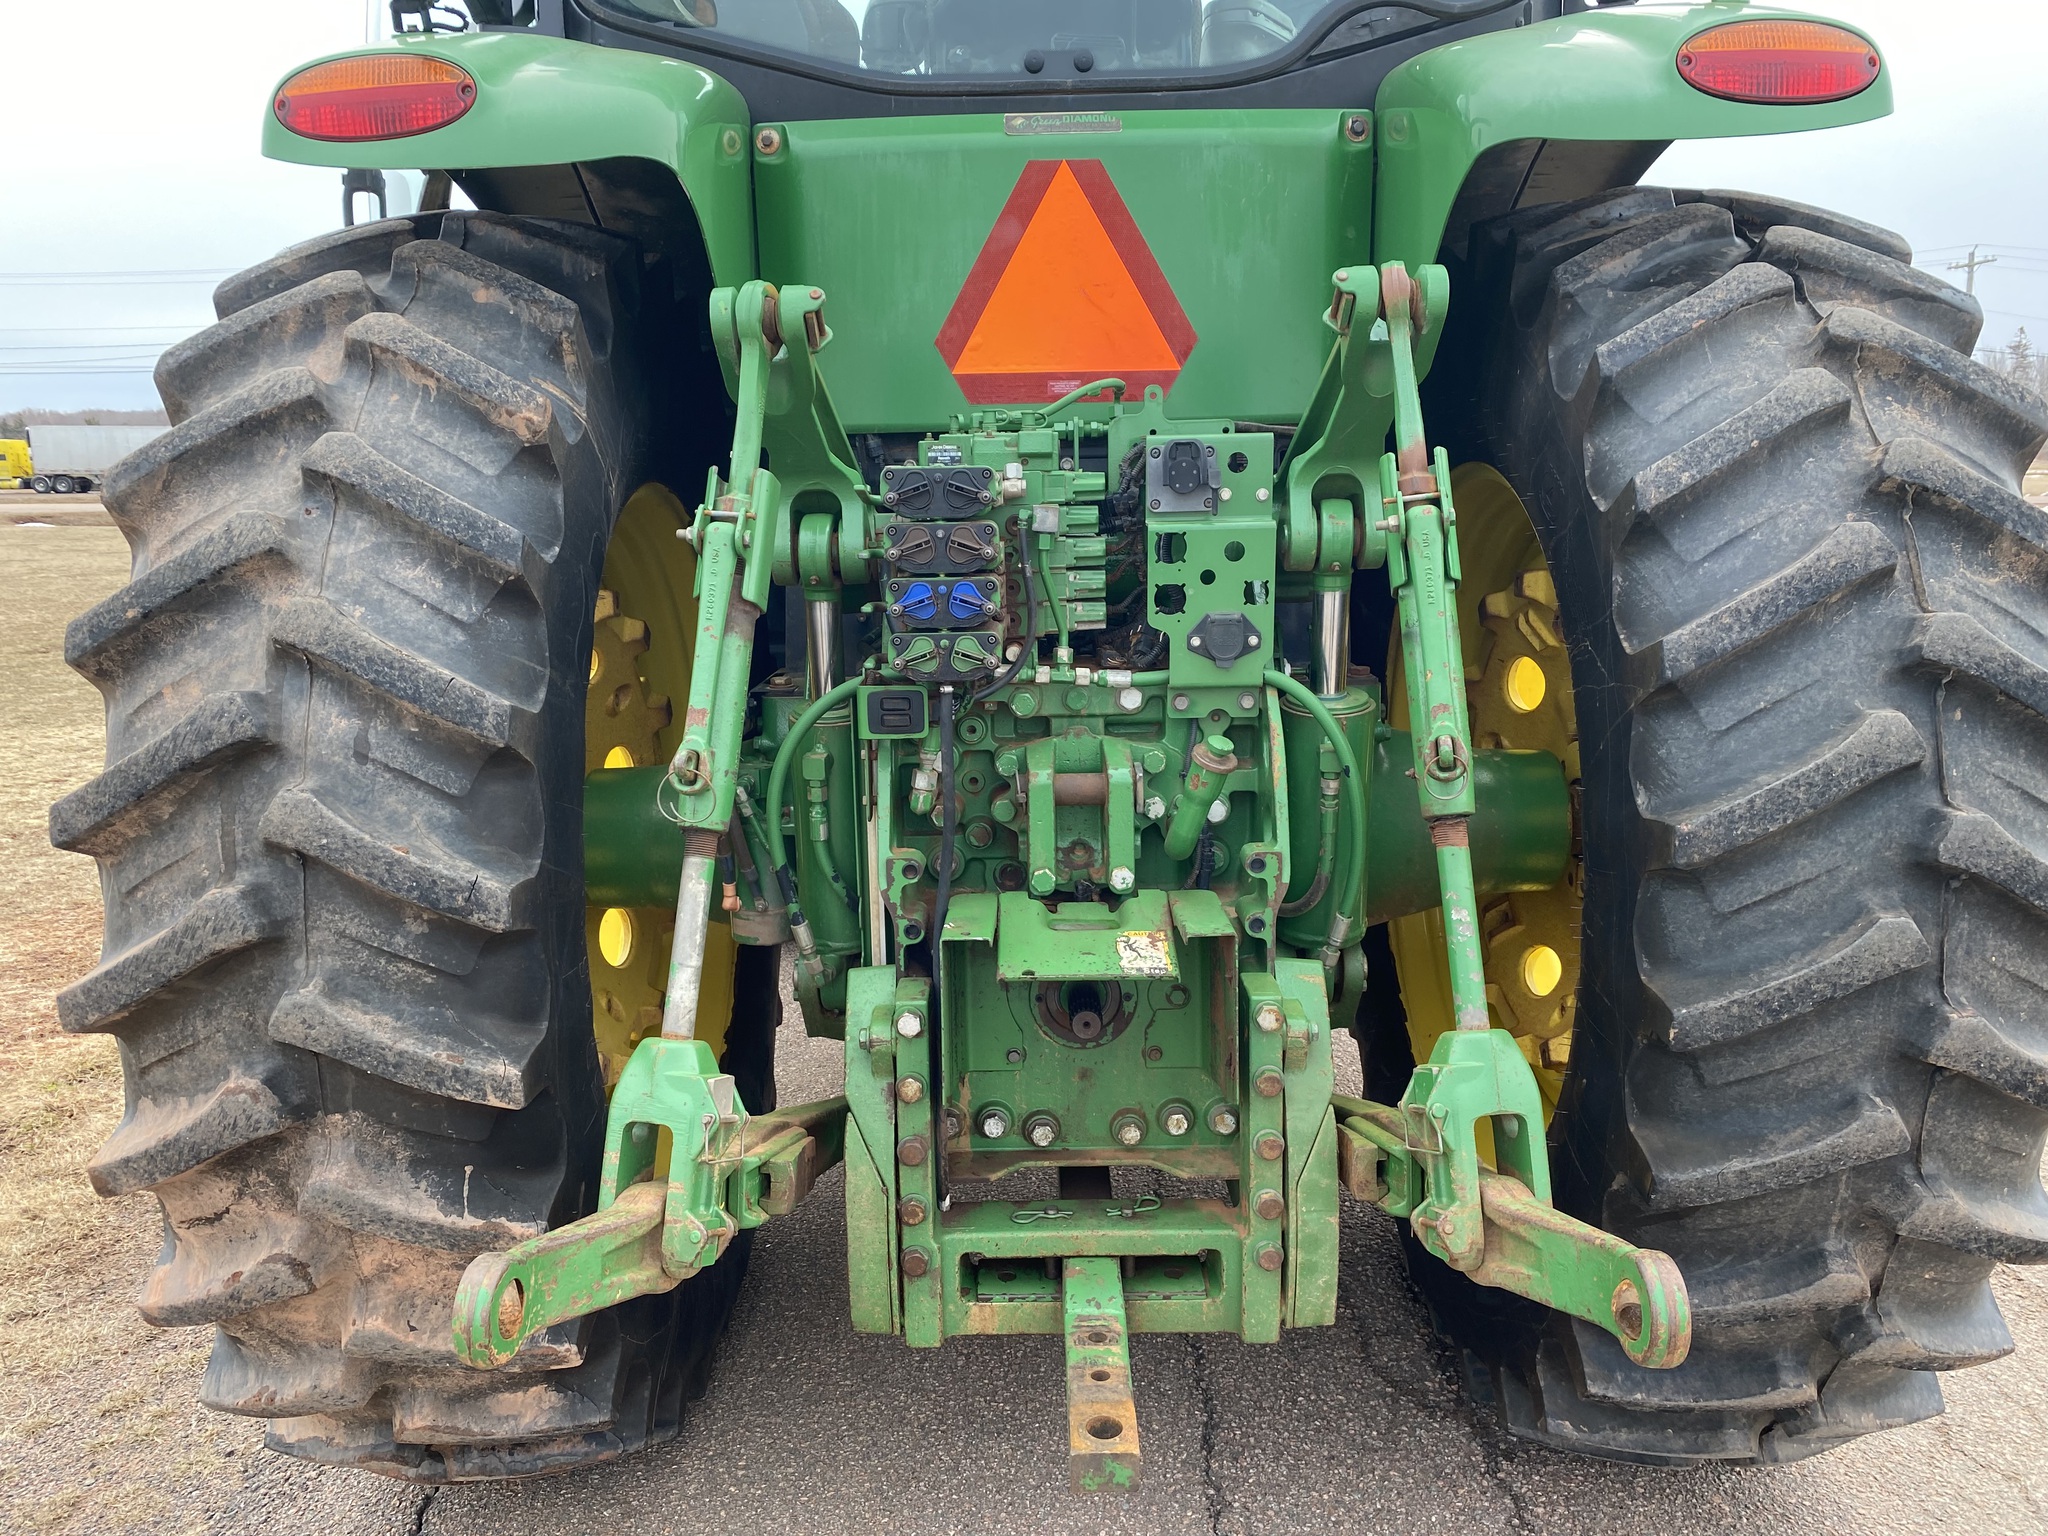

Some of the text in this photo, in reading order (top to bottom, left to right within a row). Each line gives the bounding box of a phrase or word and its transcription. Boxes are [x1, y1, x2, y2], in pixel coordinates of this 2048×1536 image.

[1027, 116, 1062, 129] Green
[1062, 114, 1116, 124] DIAMOND
[1421, 529, 1431, 548] USA
[711, 547, 721, 564] USA
